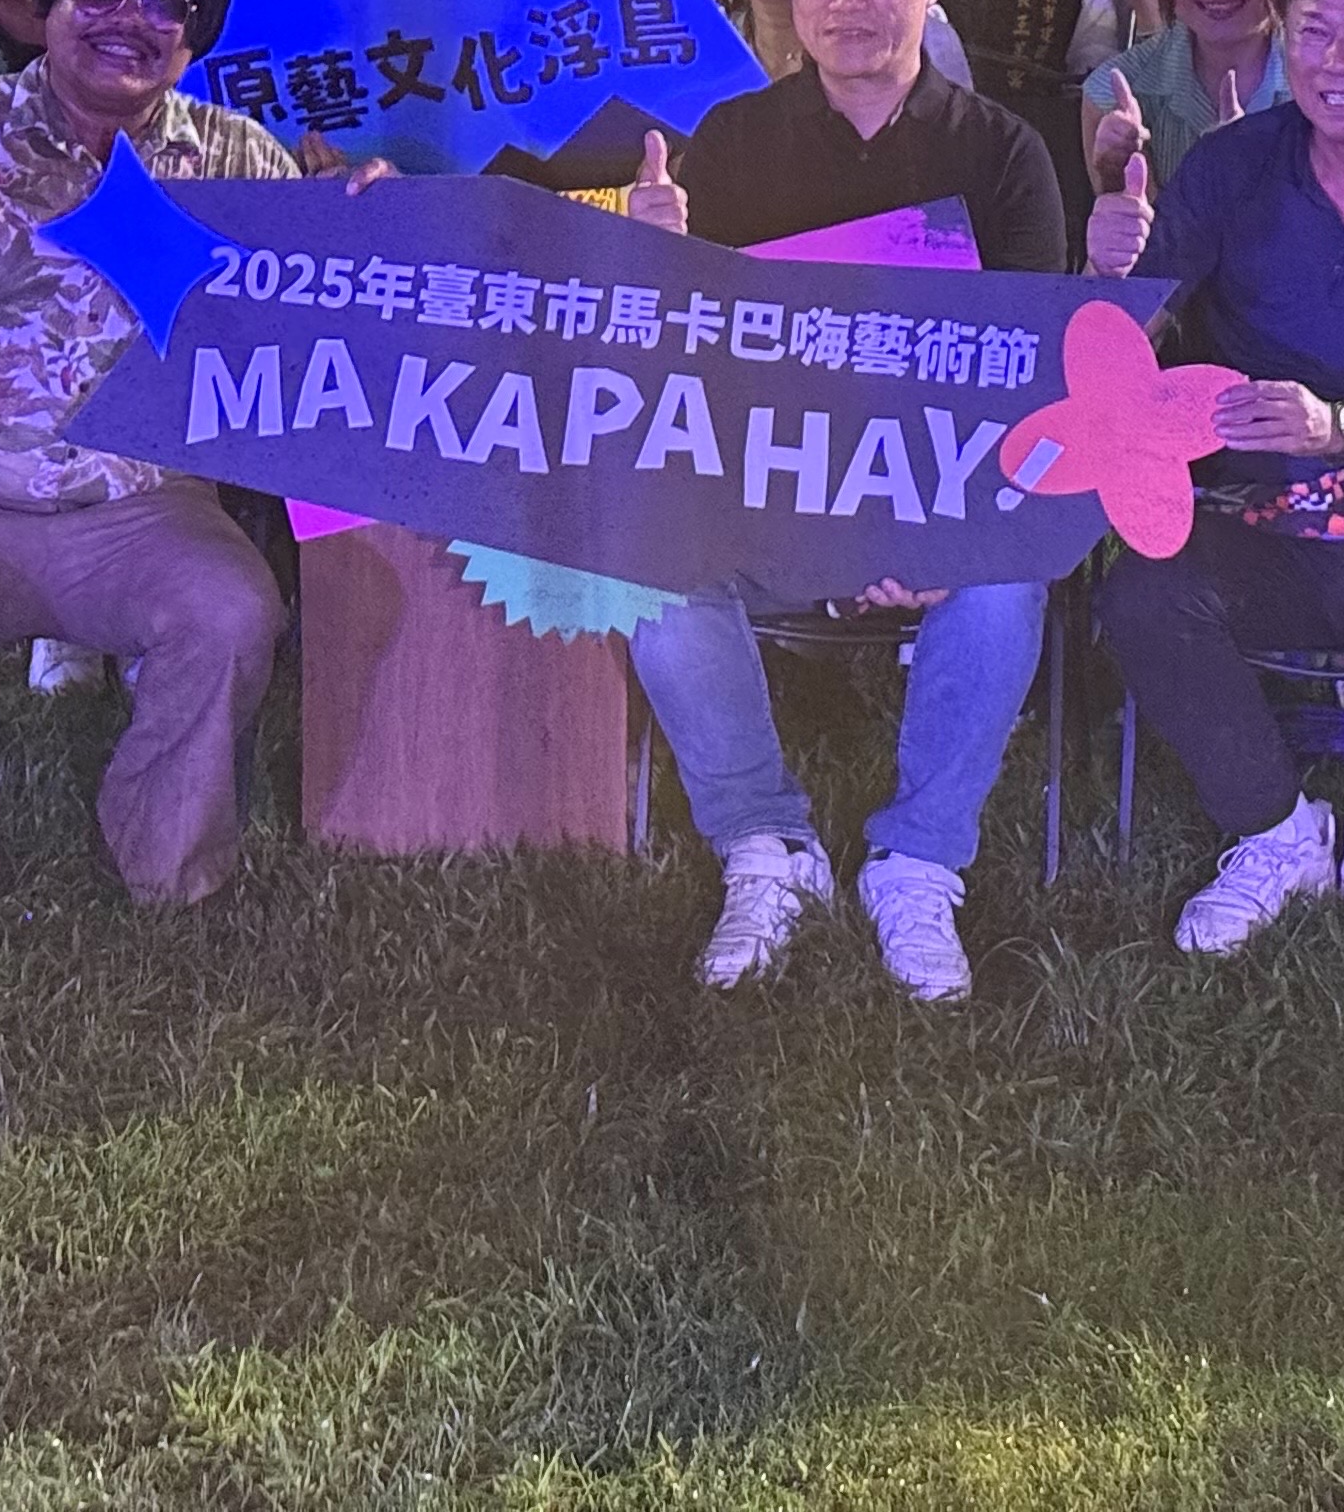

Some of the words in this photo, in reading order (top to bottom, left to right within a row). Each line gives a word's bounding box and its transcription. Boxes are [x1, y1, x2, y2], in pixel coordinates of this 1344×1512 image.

[204, 246, 1040, 389] 2025年臺東市馬卡巴嗨藝術節
